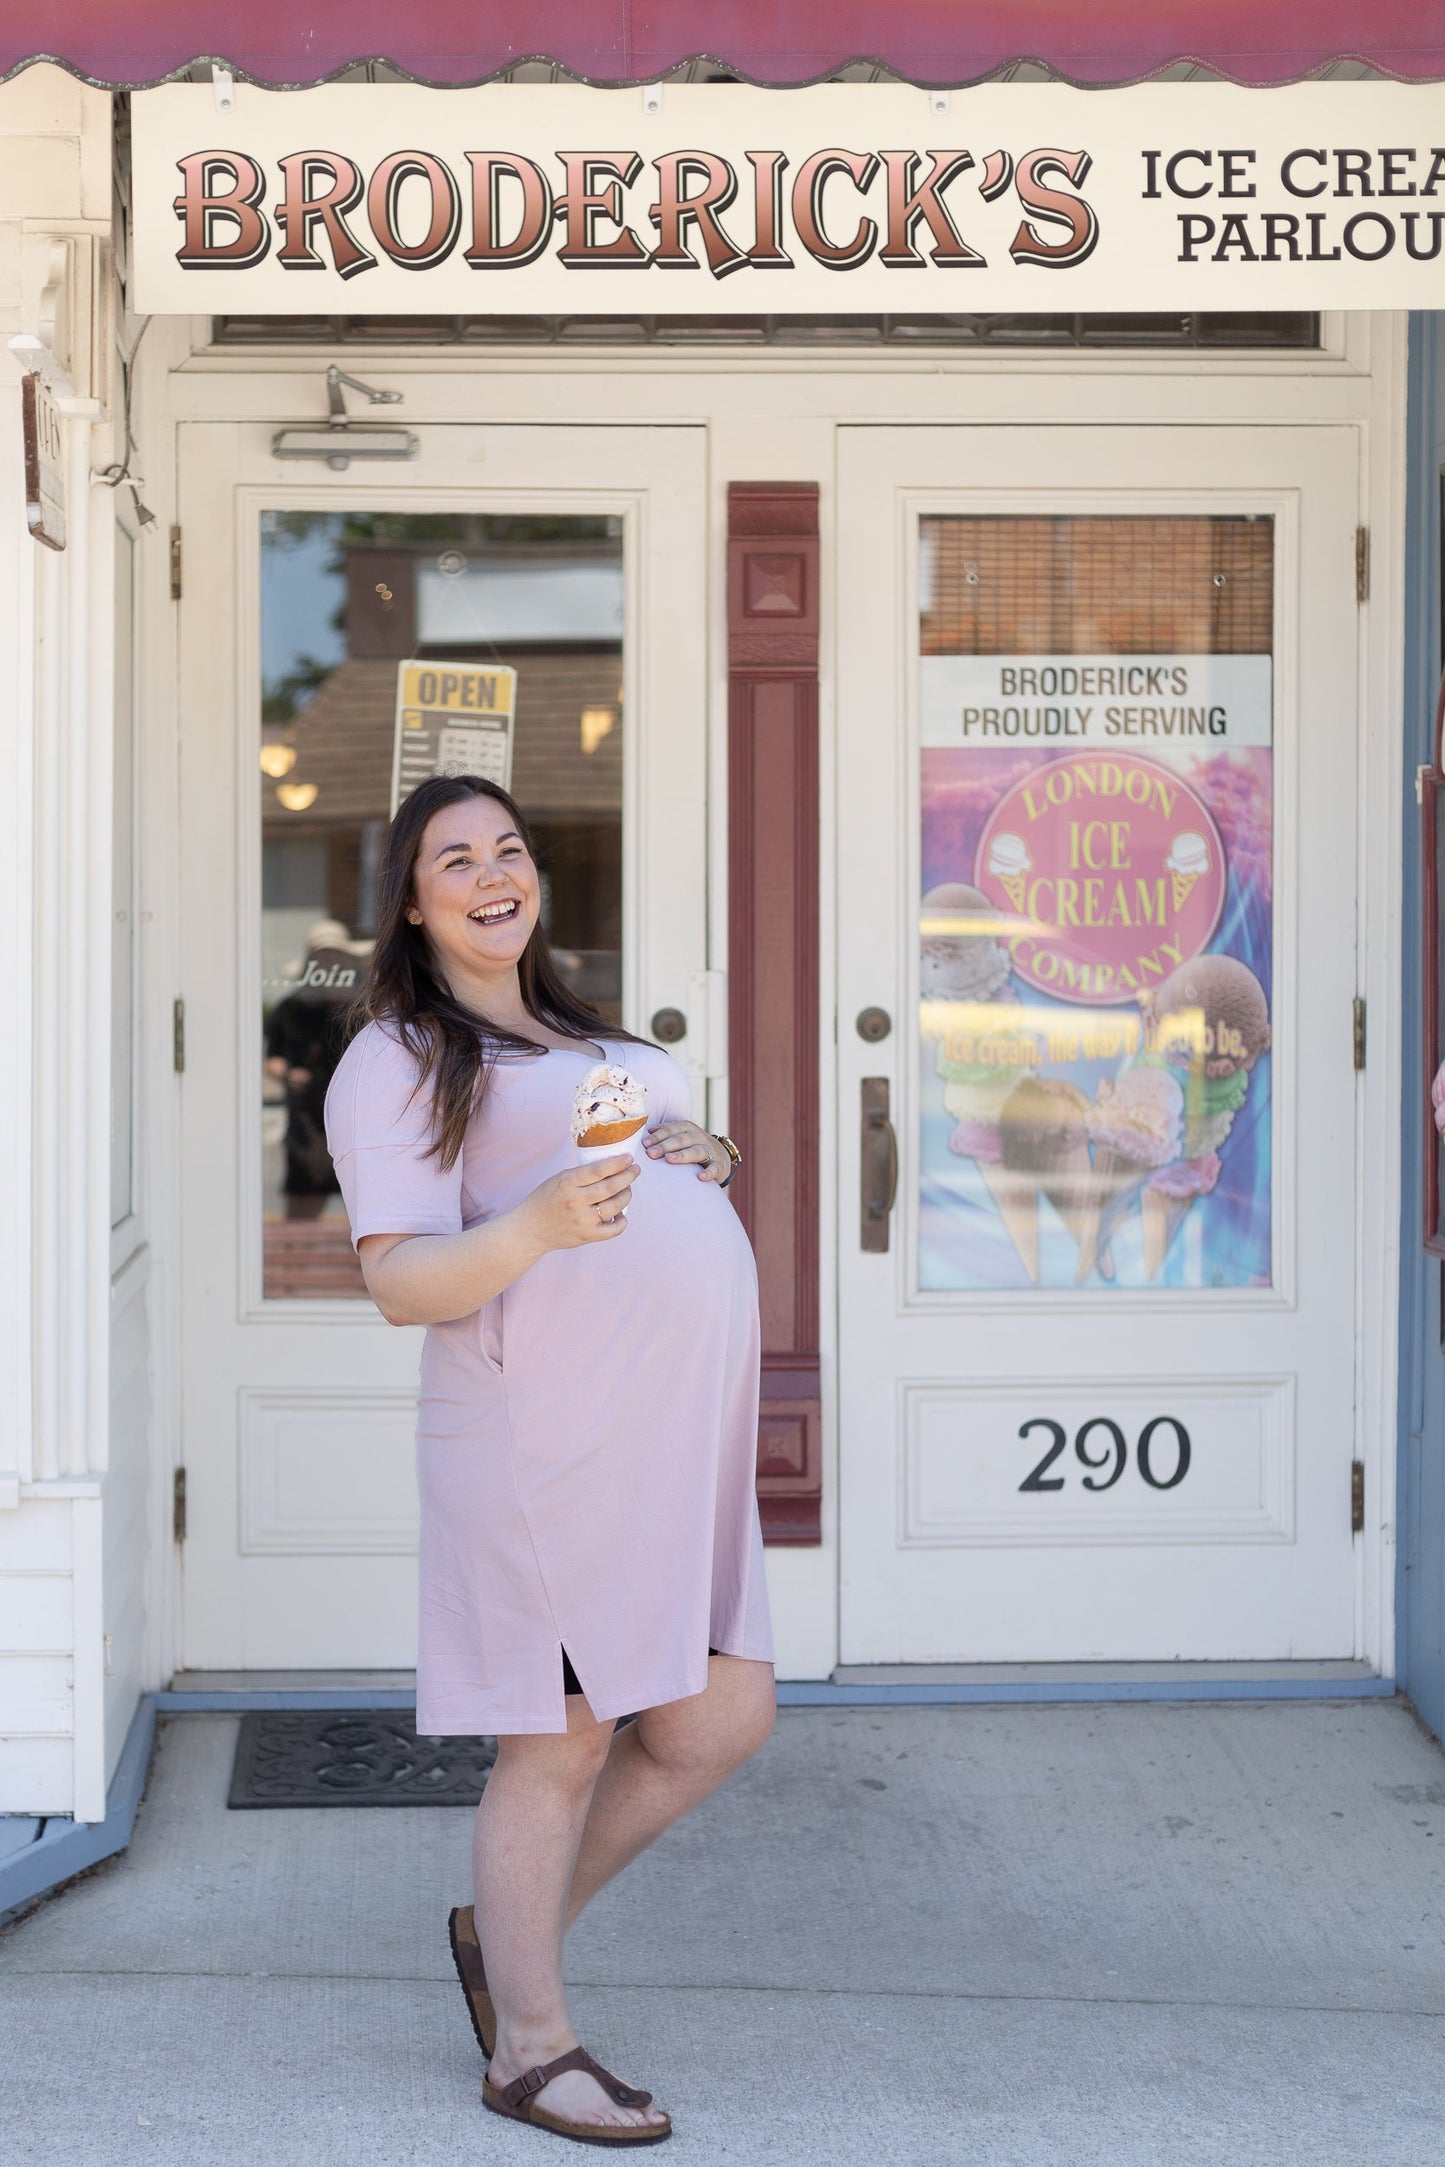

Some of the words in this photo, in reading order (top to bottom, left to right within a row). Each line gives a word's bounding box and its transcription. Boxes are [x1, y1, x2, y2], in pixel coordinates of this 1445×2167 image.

[1141, 149, 1257, 198] ICE
[173, 148, 1099, 281] BRODERICK'S
[1177, 211, 1445, 262] PARLOU
[418, 672, 497, 708] OPEN
[1000, 667, 1188, 697] BRODERICK'S
[963, 707, 1092, 736] PROUDLY
[1105, 706, 1227, 736] SERVING
[1020, 762, 1178, 822] LONDON
[1069, 820, 1132, 870] ICE
[1027, 878, 1168, 927] CREAM
[1008, 932, 1184, 993] COMPANY
[945, 1028, 974, 1063] Ice
[1018, 1416, 1191, 1491] 290
